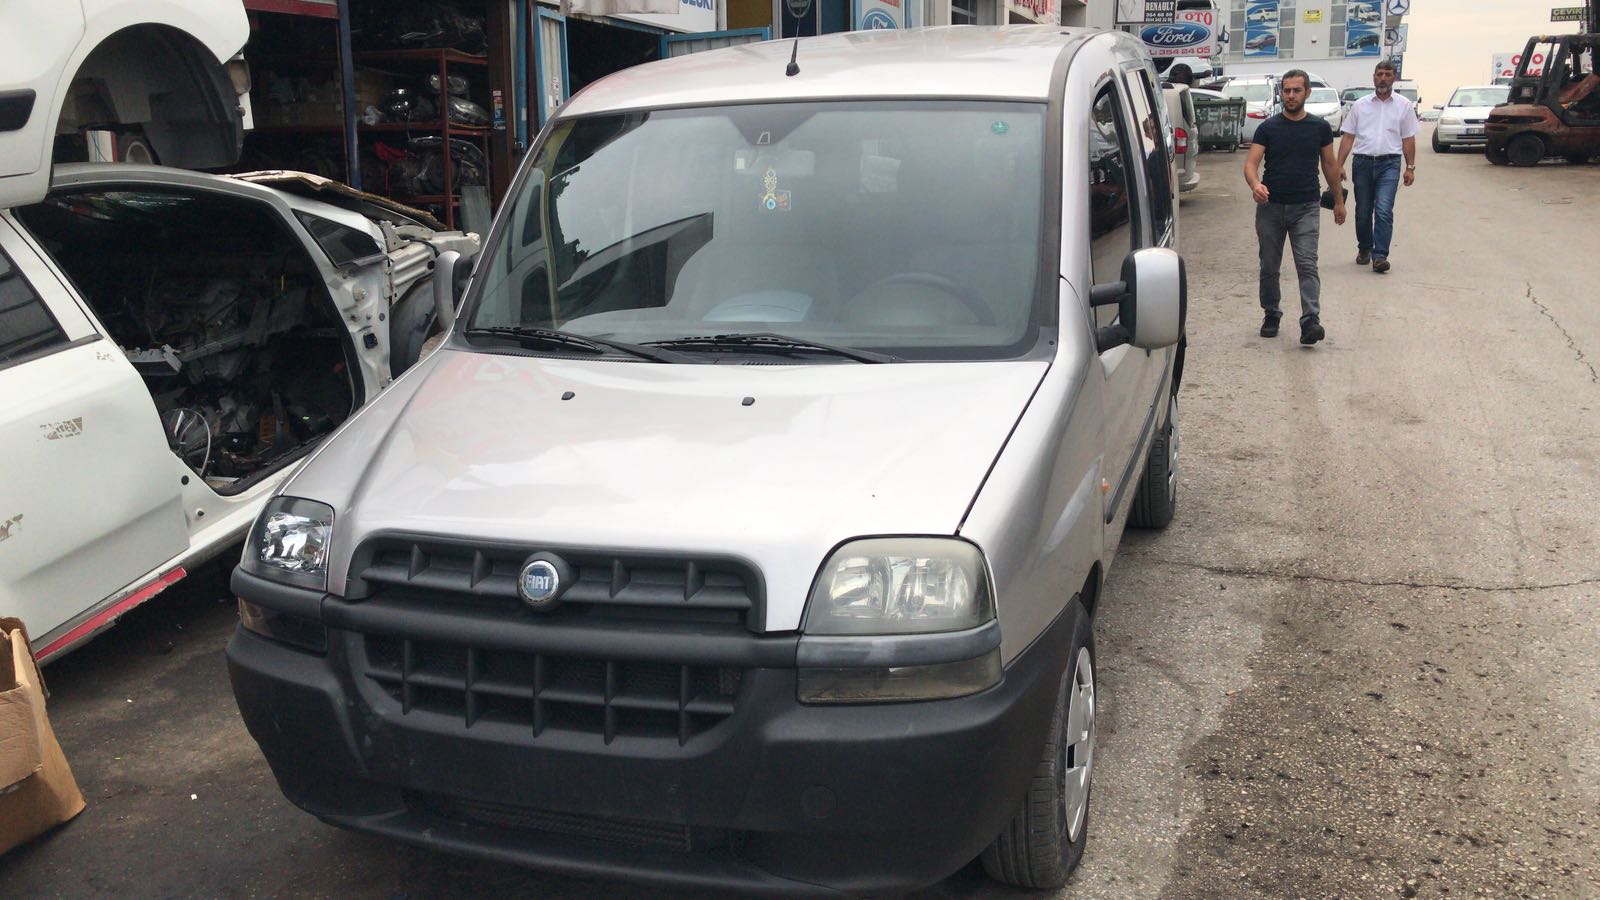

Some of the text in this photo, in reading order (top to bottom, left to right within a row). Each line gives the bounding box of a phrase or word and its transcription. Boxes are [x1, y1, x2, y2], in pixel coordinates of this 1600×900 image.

[1145, 2, 1174, 11] RENAULT
[1185, 12, 1213, 26] OTO
[1153, 26, 1195, 43] Ford
[526, 575, 550, 590] FIAT
